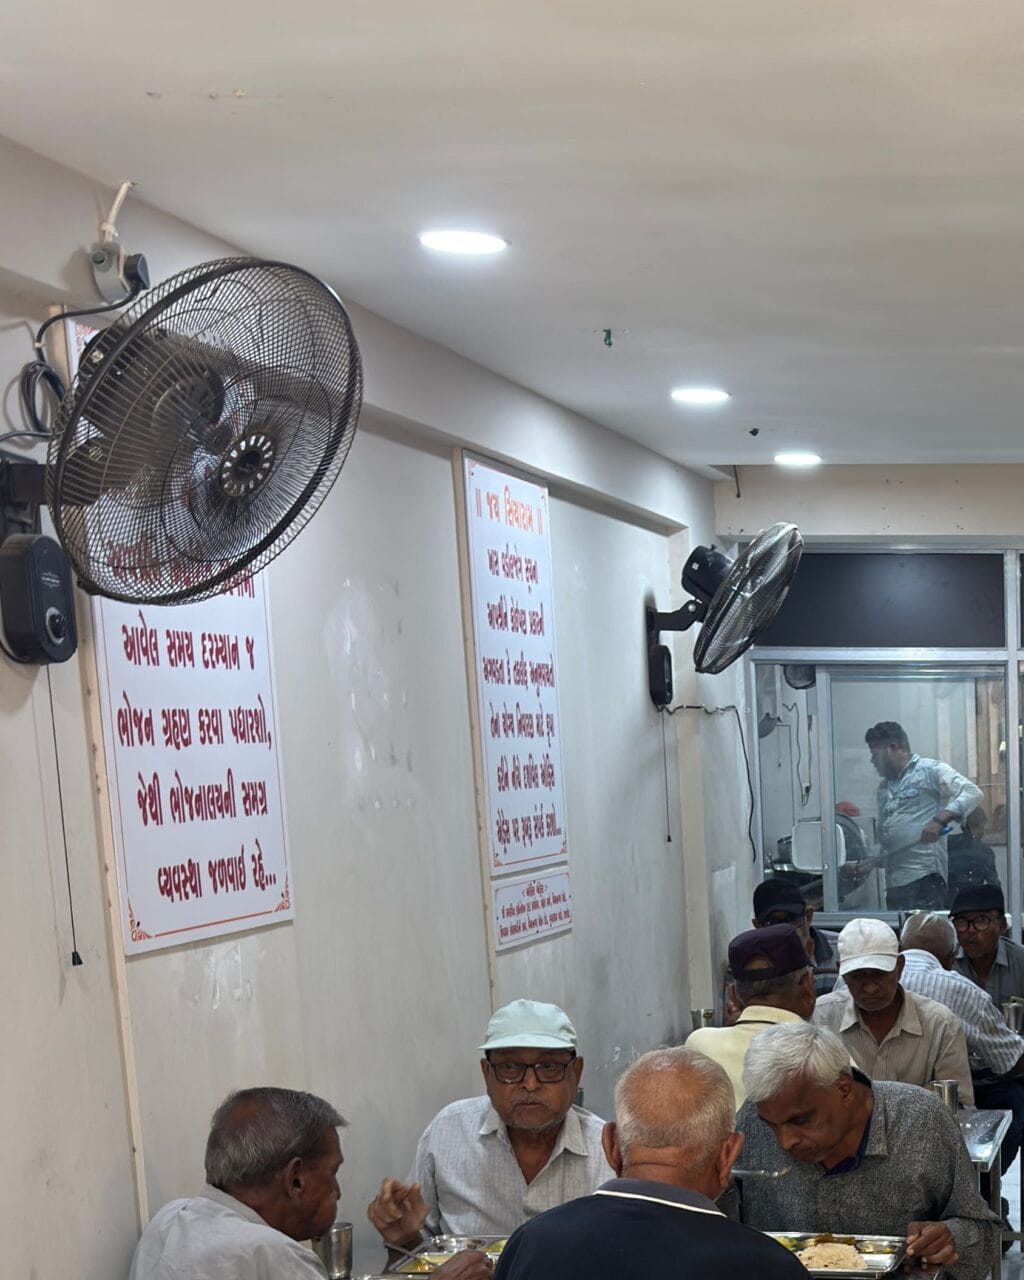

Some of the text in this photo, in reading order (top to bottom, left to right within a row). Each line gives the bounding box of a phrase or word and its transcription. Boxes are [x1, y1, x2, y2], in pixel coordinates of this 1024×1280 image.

[122, 610, 255, 670] આવેલ સમય દરમ્યાન જ
[117, 691, 272, 751] ભોજન ગ્રહણ કરવા પધારશો,
[137, 767, 268, 826] જેથી ભોજનાલયની સમગ્ર
[158, 858, 202, 903] વ્યવસ્થા
[208, 844, 246, 894] જળવાઈ
